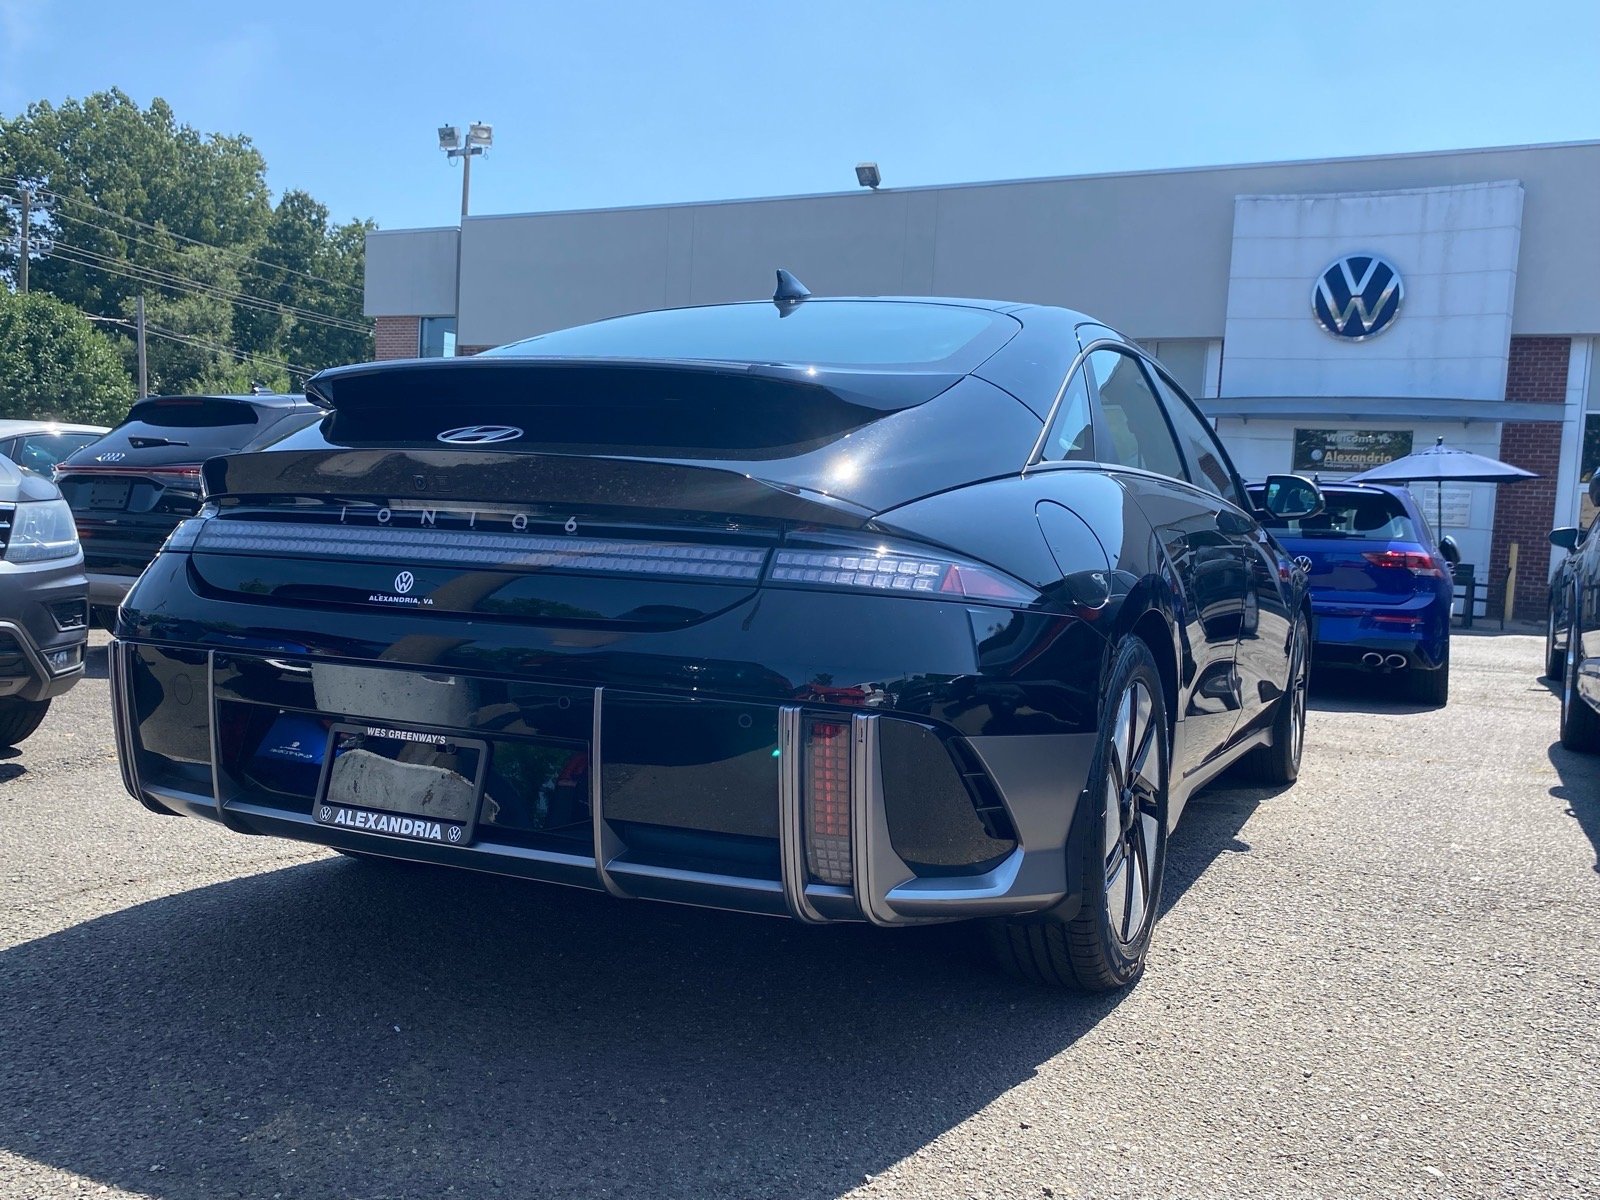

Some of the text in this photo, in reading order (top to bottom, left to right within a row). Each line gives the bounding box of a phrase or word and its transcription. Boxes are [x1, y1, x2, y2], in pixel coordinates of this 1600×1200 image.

[1326, 433, 1375, 443] Welcome
[1324, 451, 1392, 463] Alexandria
[340, 506, 578, 532] IONIQ 6
[368, 595, 421, 605] ALEXANDRIA,
[367, 727, 447, 745] WES GREENWAY'S
[334, 809, 442, 840] ALEXANDRIA
